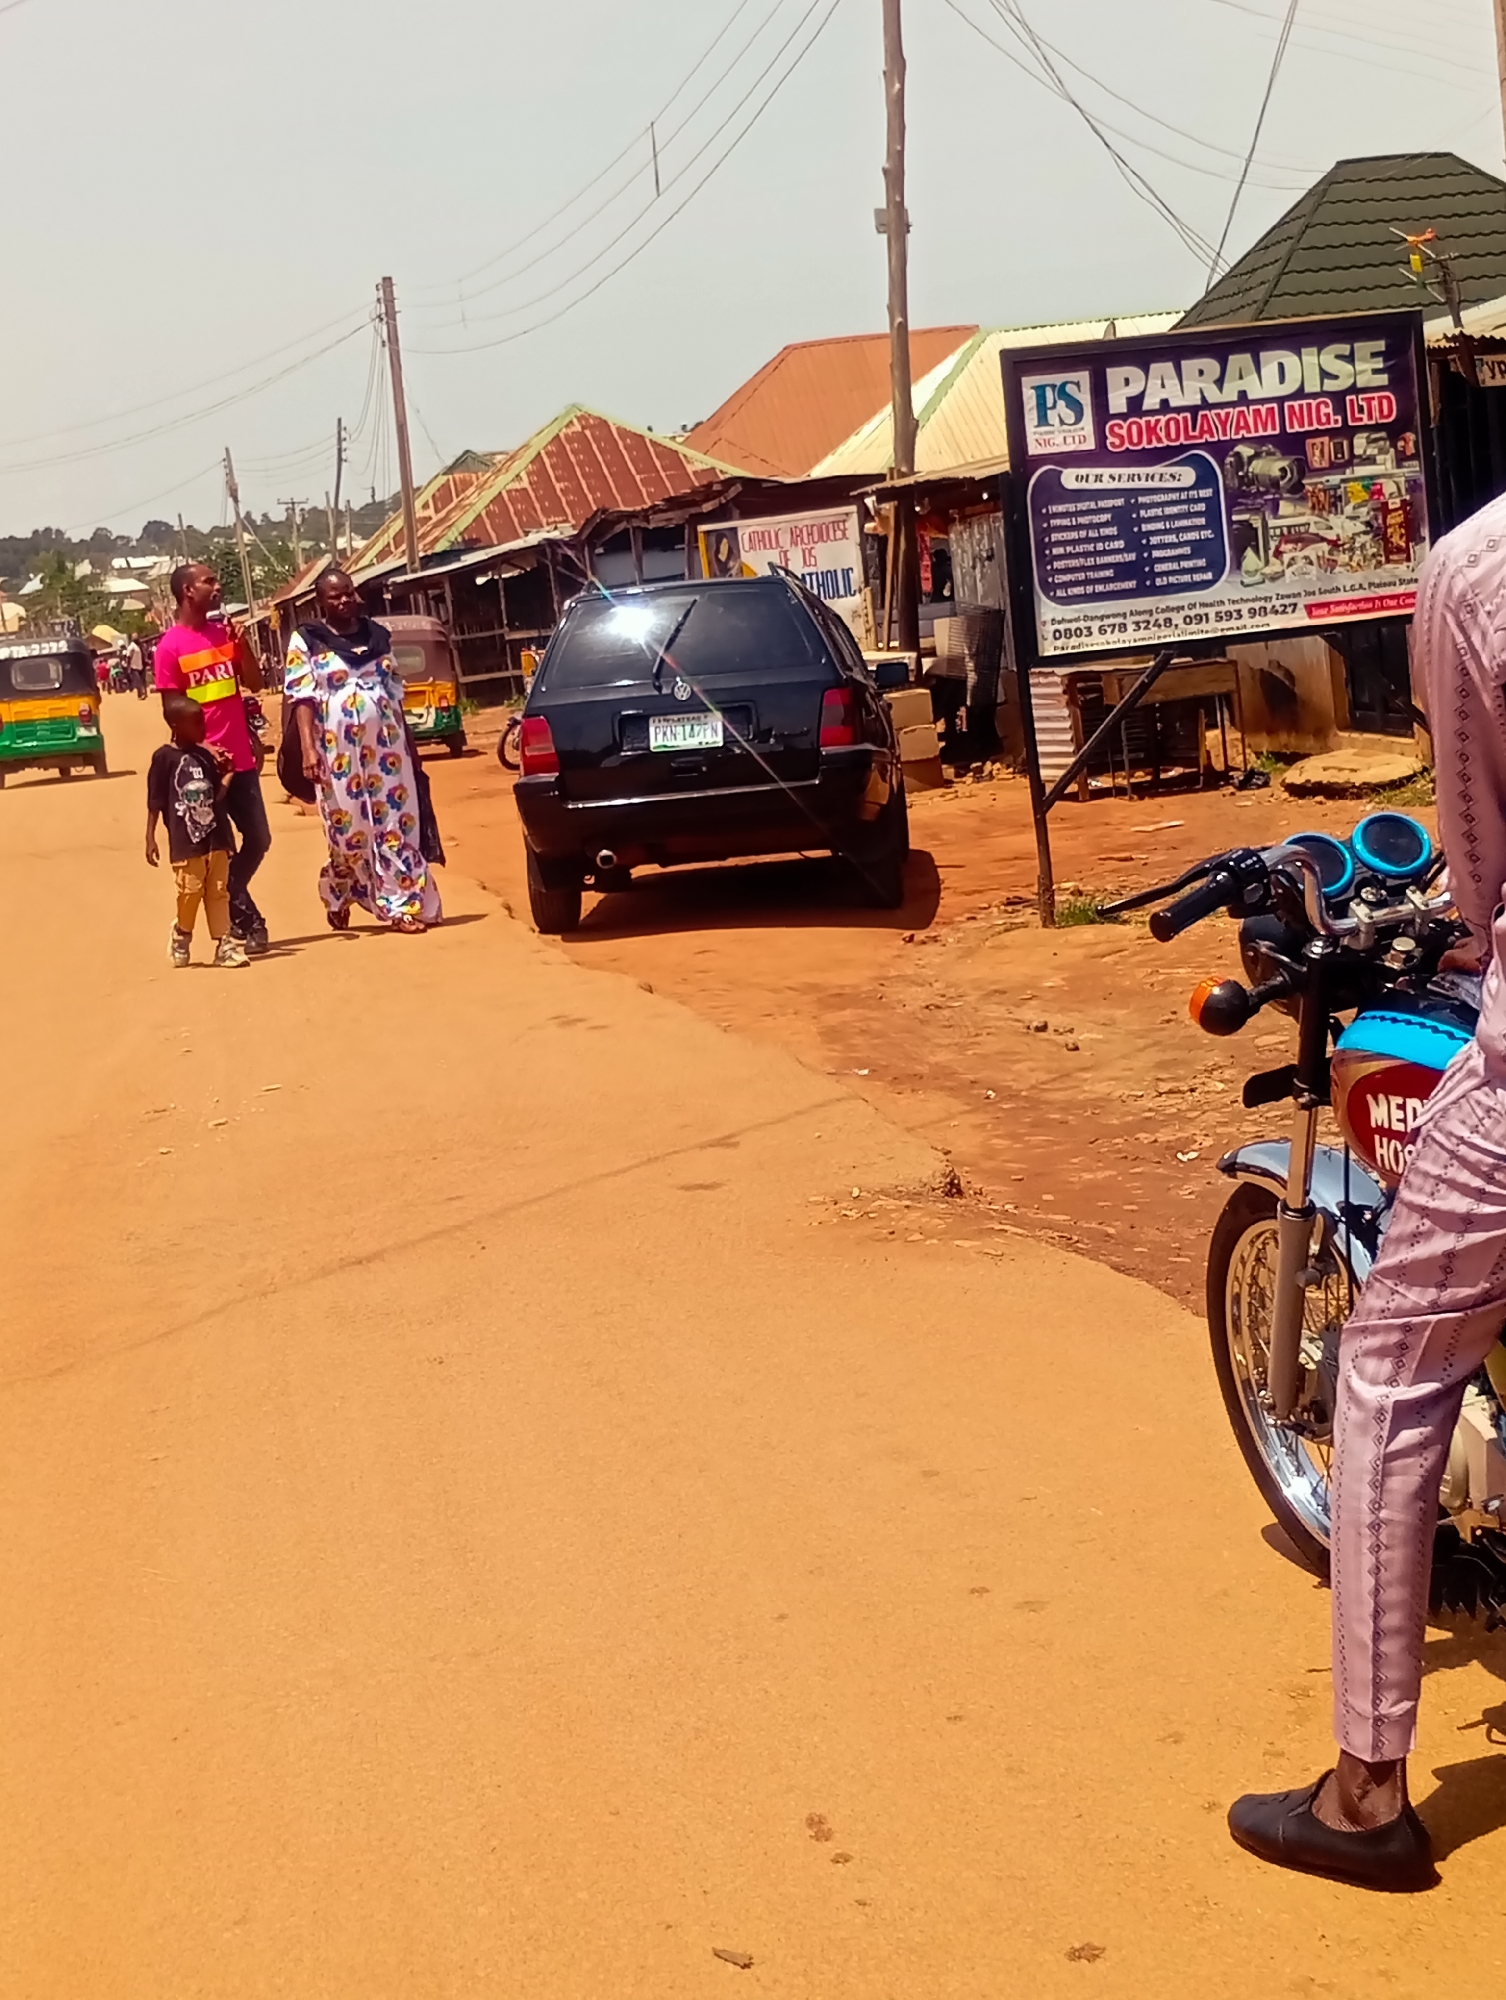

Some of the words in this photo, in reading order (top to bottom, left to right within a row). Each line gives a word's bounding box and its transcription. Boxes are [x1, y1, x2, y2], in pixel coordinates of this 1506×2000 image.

[1106, 340, 1389, 414] PARADISE
[1030, 380, 1084, 428] PS
[1106, 403, 1279, 451] SOKOLAYAM
[1285, 398, 1341, 433] NIG.
[1347, 391, 1396, 426] LTD
[1063, 434, 1087, 446] LTD
[1075, 473, 1104, 484] OUR
[1107, 471, 1183, 484] SERVICES:
[741, 528, 784, 554] CATHOLIC
[789, 519, 850, 548] ARCHDIOCESE
[1066, 543, 1095, 554] PLASTIC
[1104, 540, 1125, 550] CARD
[779, 549, 791, 570] OF
[801, 546, 818, 569] JOS
[1129, 607, 1154, 619] Along
[1155, 603, 1186, 616] College
[1187, 601, 1198, 611] Of
[1198, 599, 1226, 610] Health
[1227, 594, 1274, 607] Technology
[1303, 588, 1317, 598] Jos
[1318, 584, 1342, 596] South
[1368, 578, 1397, 590] Plateau
[1398, 576, 1419, 587] State
[1052, 625, 1094, 641] 0803
[1098, 622, 1128, 636] 678
[1131, 617, 1179, 632] 3248,
[1183, 612, 1210, 626] 091
[1214, 608, 1243, 622] 593
[1247, 602, 1298, 619] 98427
